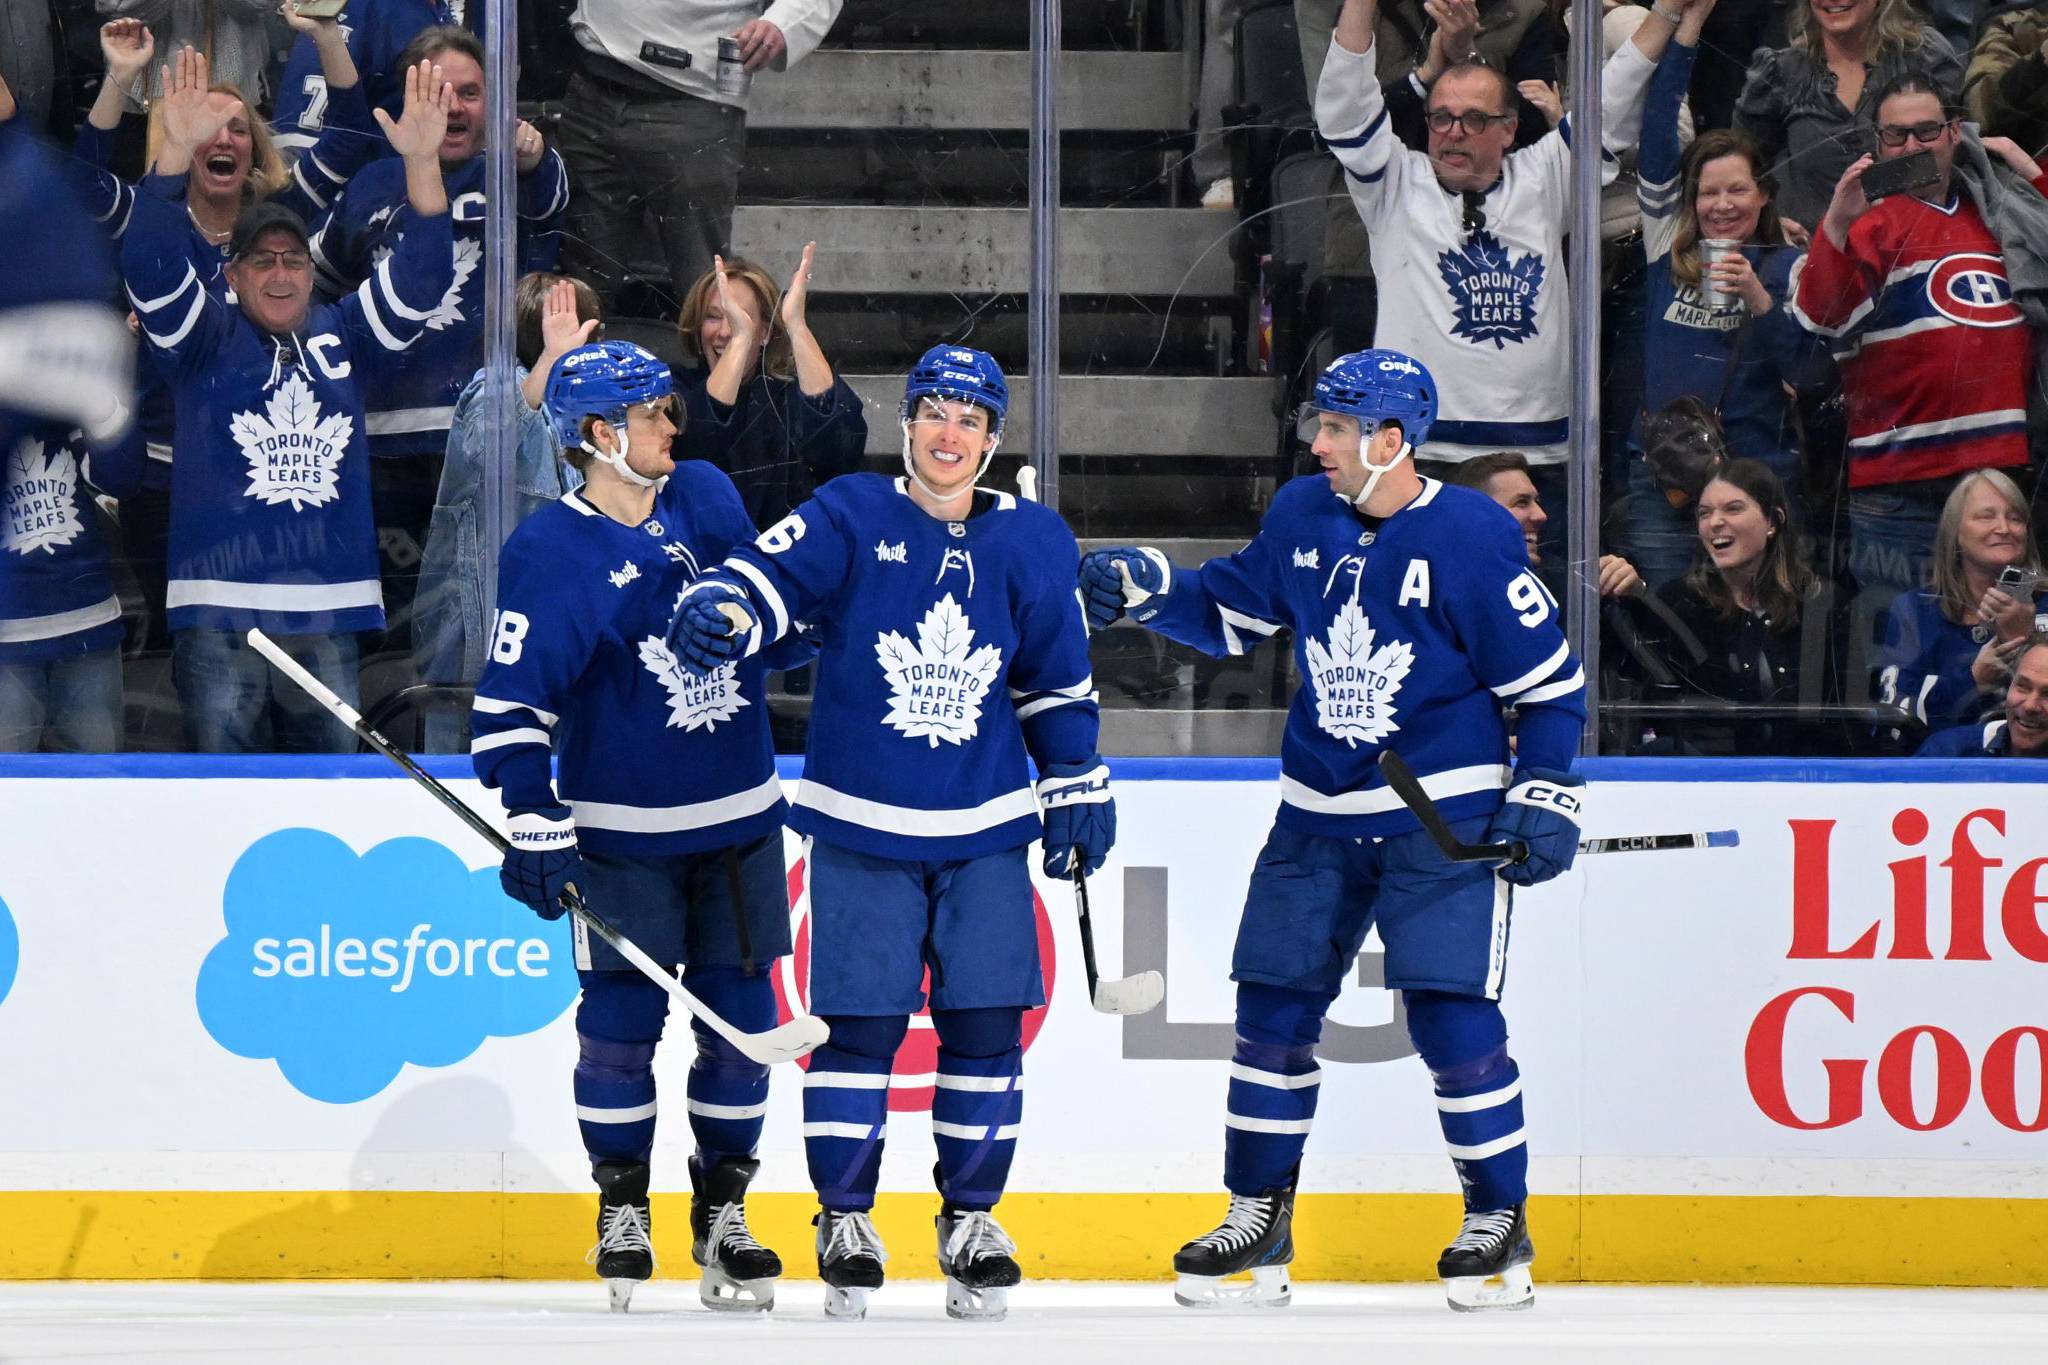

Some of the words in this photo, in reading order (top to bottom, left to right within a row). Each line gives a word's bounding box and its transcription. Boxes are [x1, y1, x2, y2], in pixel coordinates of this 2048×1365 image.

[1458, 271, 1530, 296] TORONTO
[1471, 292, 1522, 306] MAPLE
[1471, 307, 1522, 322] LEAFS
[306, 333, 351, 380] C
[942, 370, 981, 384] CCM
[255, 433, 333, 458] TORONTO
[268, 454, 322, 468] MAPLE
[268, 469, 322, 483] LEAFS
[4, 479, 67, 504] ORONTO
[9, 495, 62, 520] MAPLE
[13, 511, 66, 535] LEAFS
[1398, 559, 1430, 608] A
[682, 667, 724, 691] MAPLE
[898, 663, 980, 692] TORONTO
[1317, 665, 1388, 691] TORONTO
[685, 684, 726, 708] LEAFS
[911, 683, 967, 703] MAPLE
[1328, 688, 1375, 703] MAPLE
[908, 699, 965, 720] LEAFS
[1328, 703, 1375, 719] LEAFS
[1617, 836, 1657, 851] CCM
[252, 923, 549, 992] salesforce
